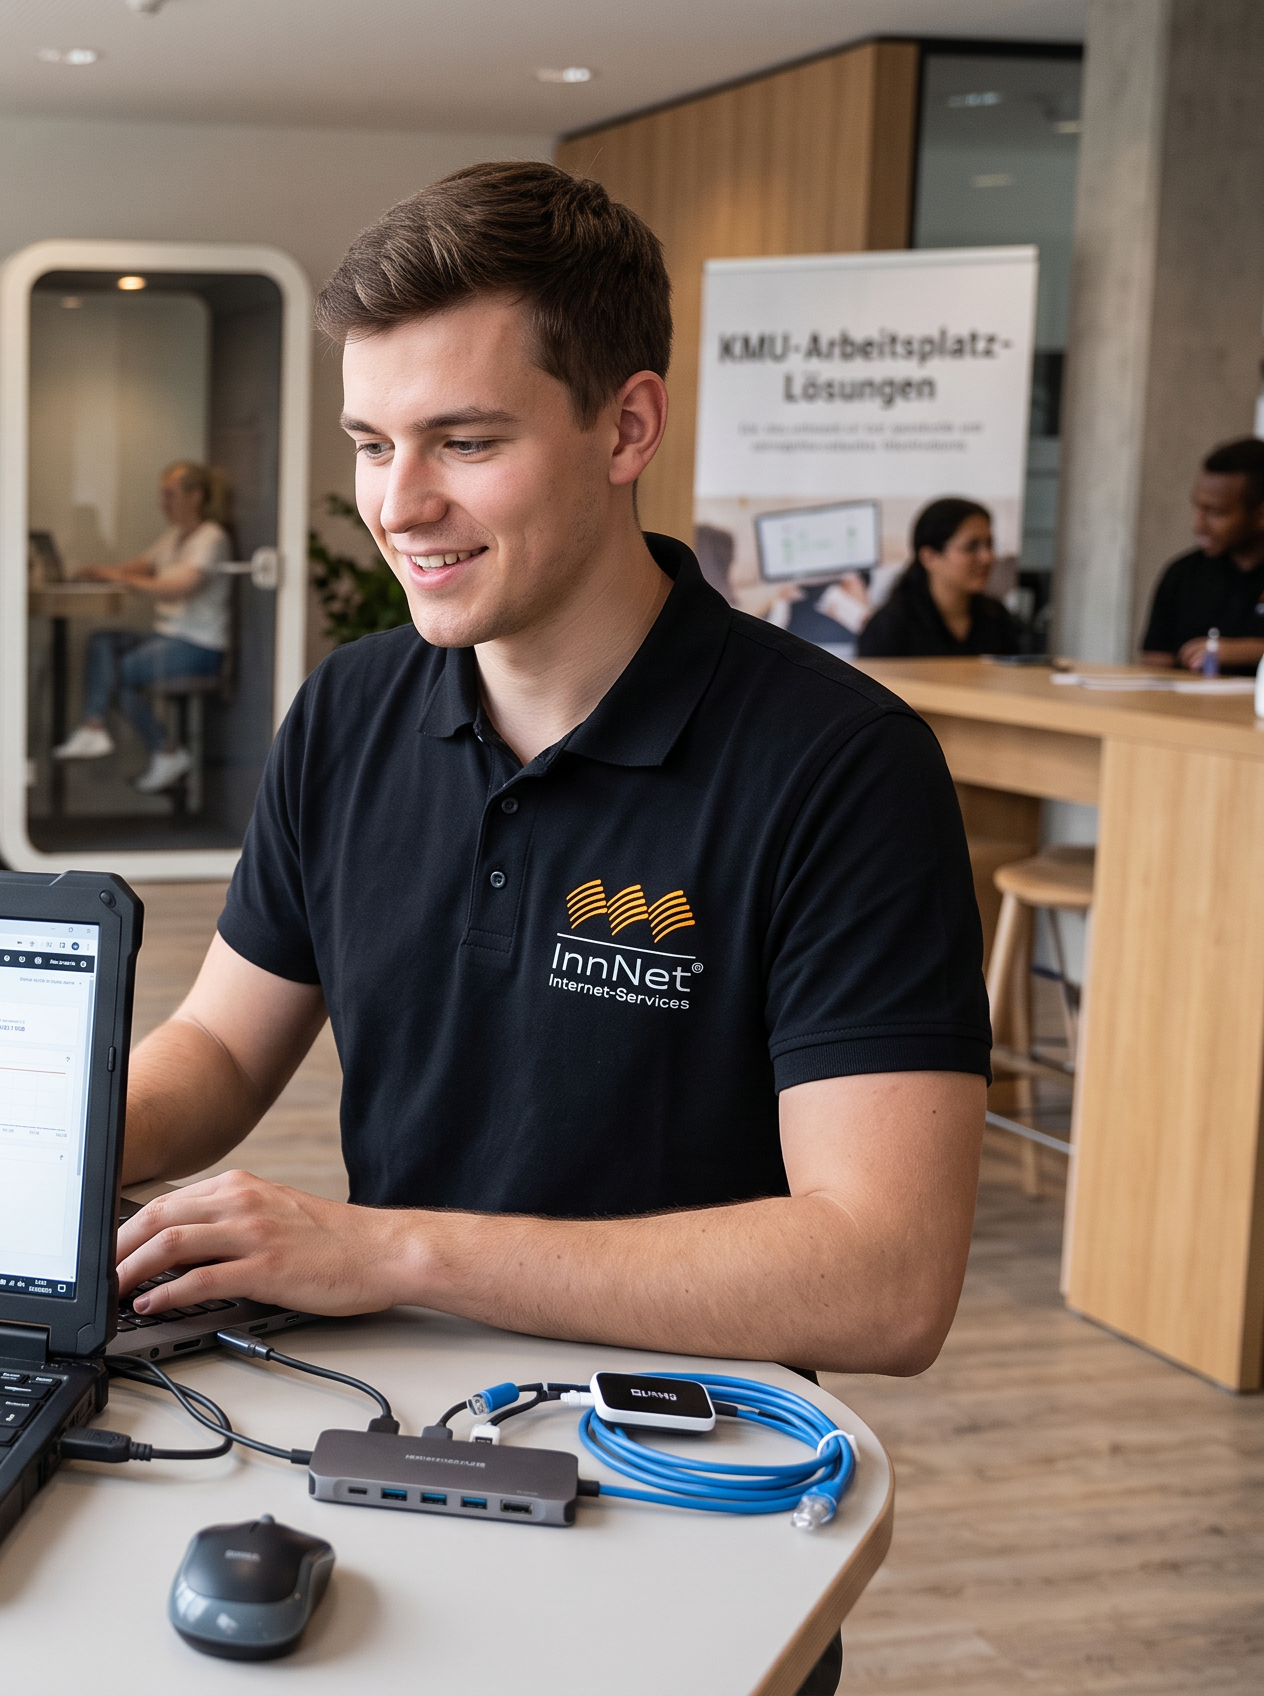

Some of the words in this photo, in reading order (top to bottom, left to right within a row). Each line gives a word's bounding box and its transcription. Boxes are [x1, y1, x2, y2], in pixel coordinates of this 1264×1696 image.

[719, 328, 1012, 366] KMU-Arbeitsplatz-
[783, 371, 937, 410] Lösungen
[548, 973, 690, 1010] Internet-Services
